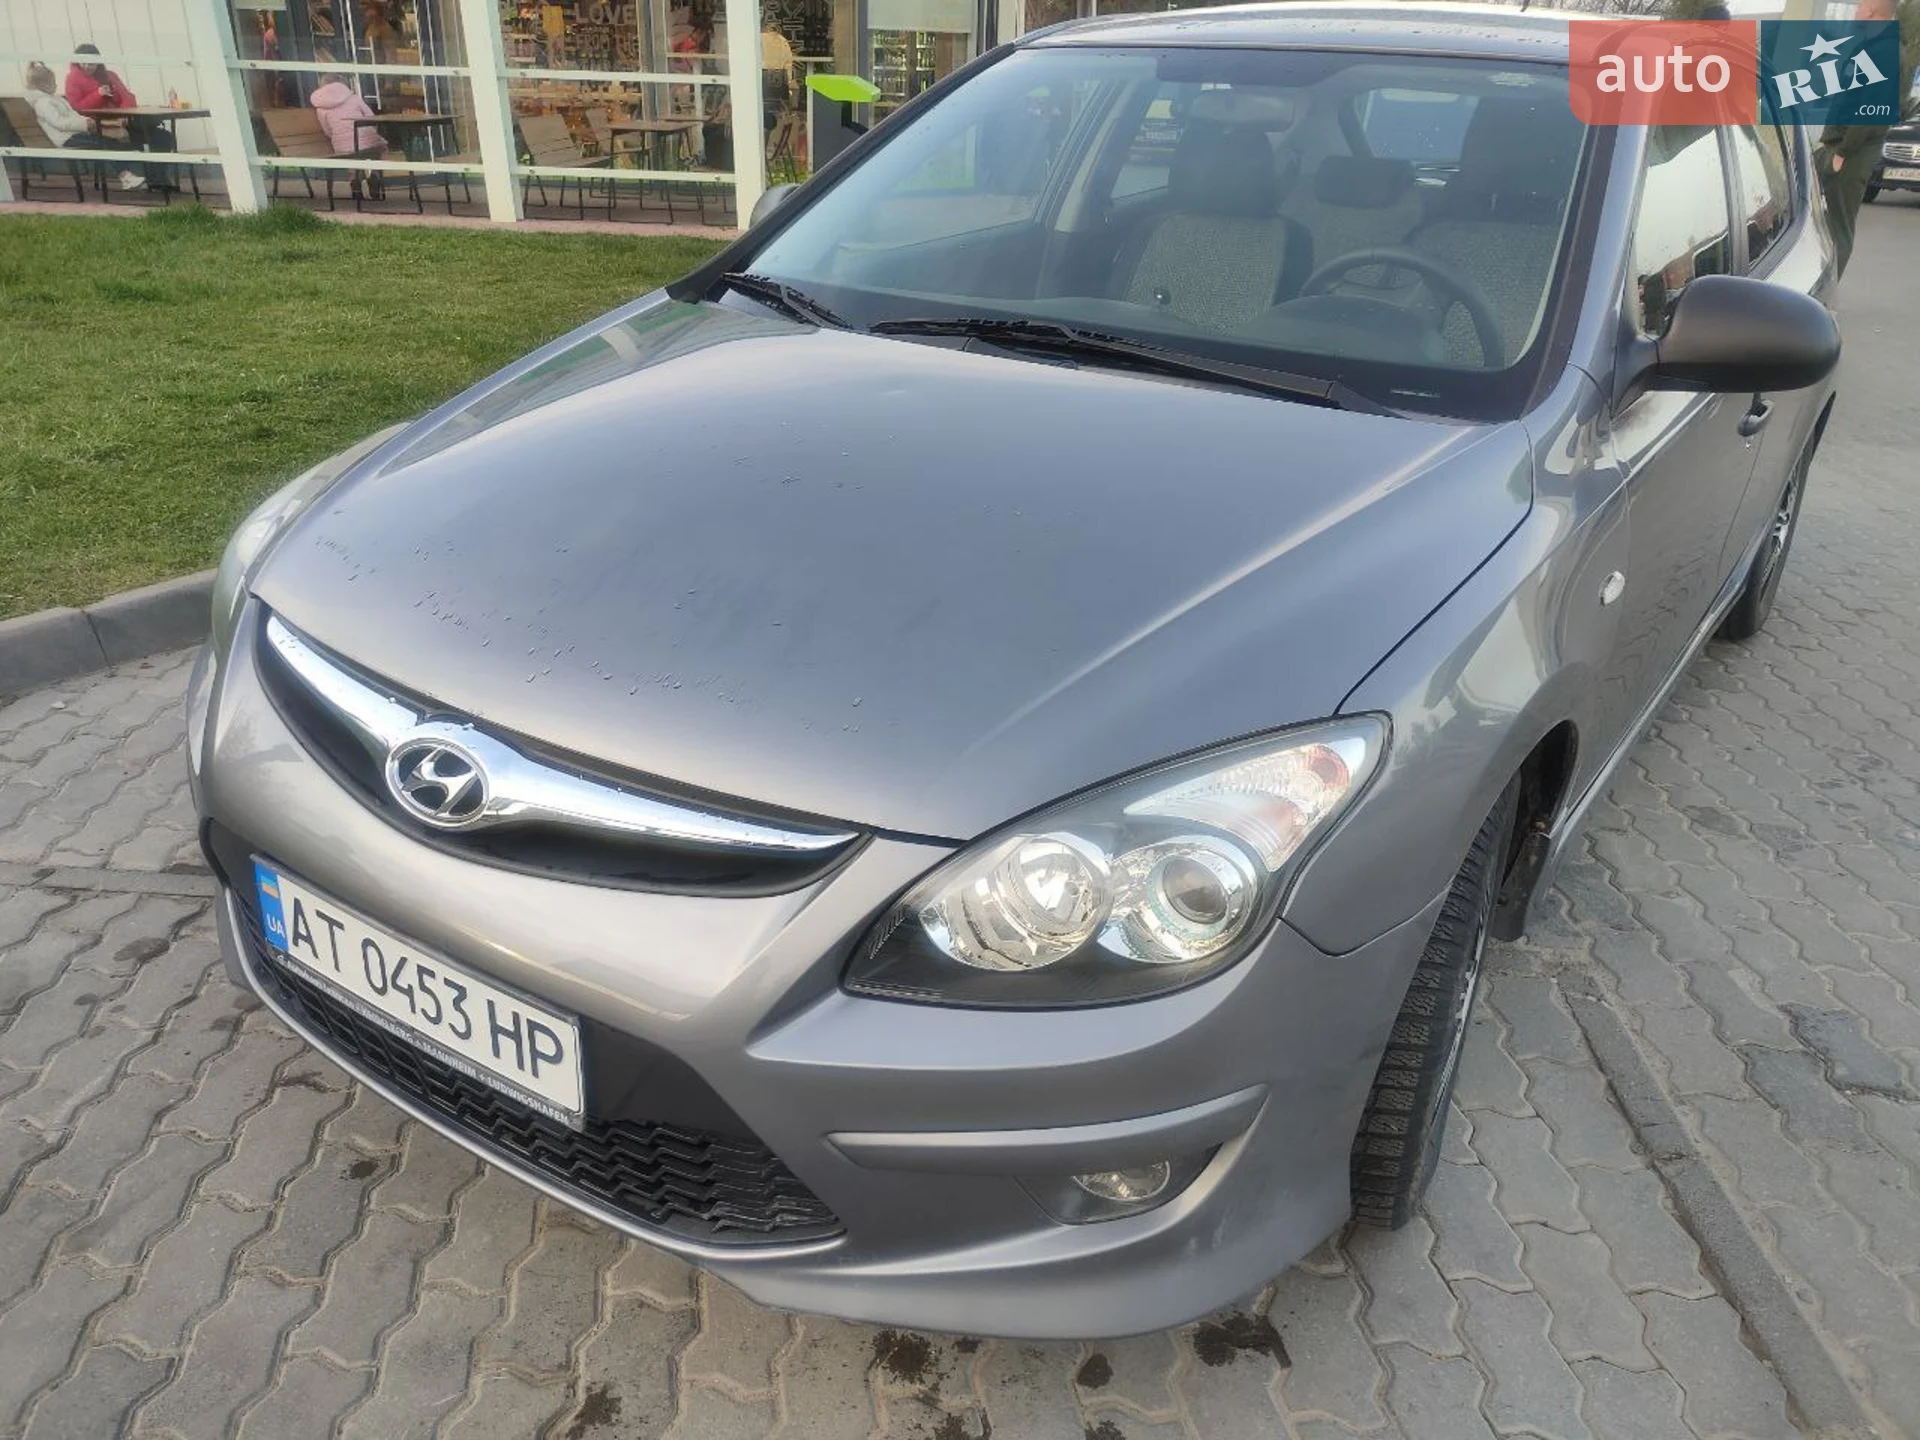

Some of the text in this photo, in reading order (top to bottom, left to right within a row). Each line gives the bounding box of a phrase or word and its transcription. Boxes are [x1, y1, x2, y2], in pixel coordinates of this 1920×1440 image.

[574, 3, 637, 25] LOVE
[266, 912, 286, 938] UA
[292, 896, 345, 973] AT
[360, 937, 472, 1041] 0453
[487, 999, 565, 1079] HP
[422, 1040, 477, 1079] MANNHEIM
[487, 1076, 570, 1125] LUDWIGSHAFEN
